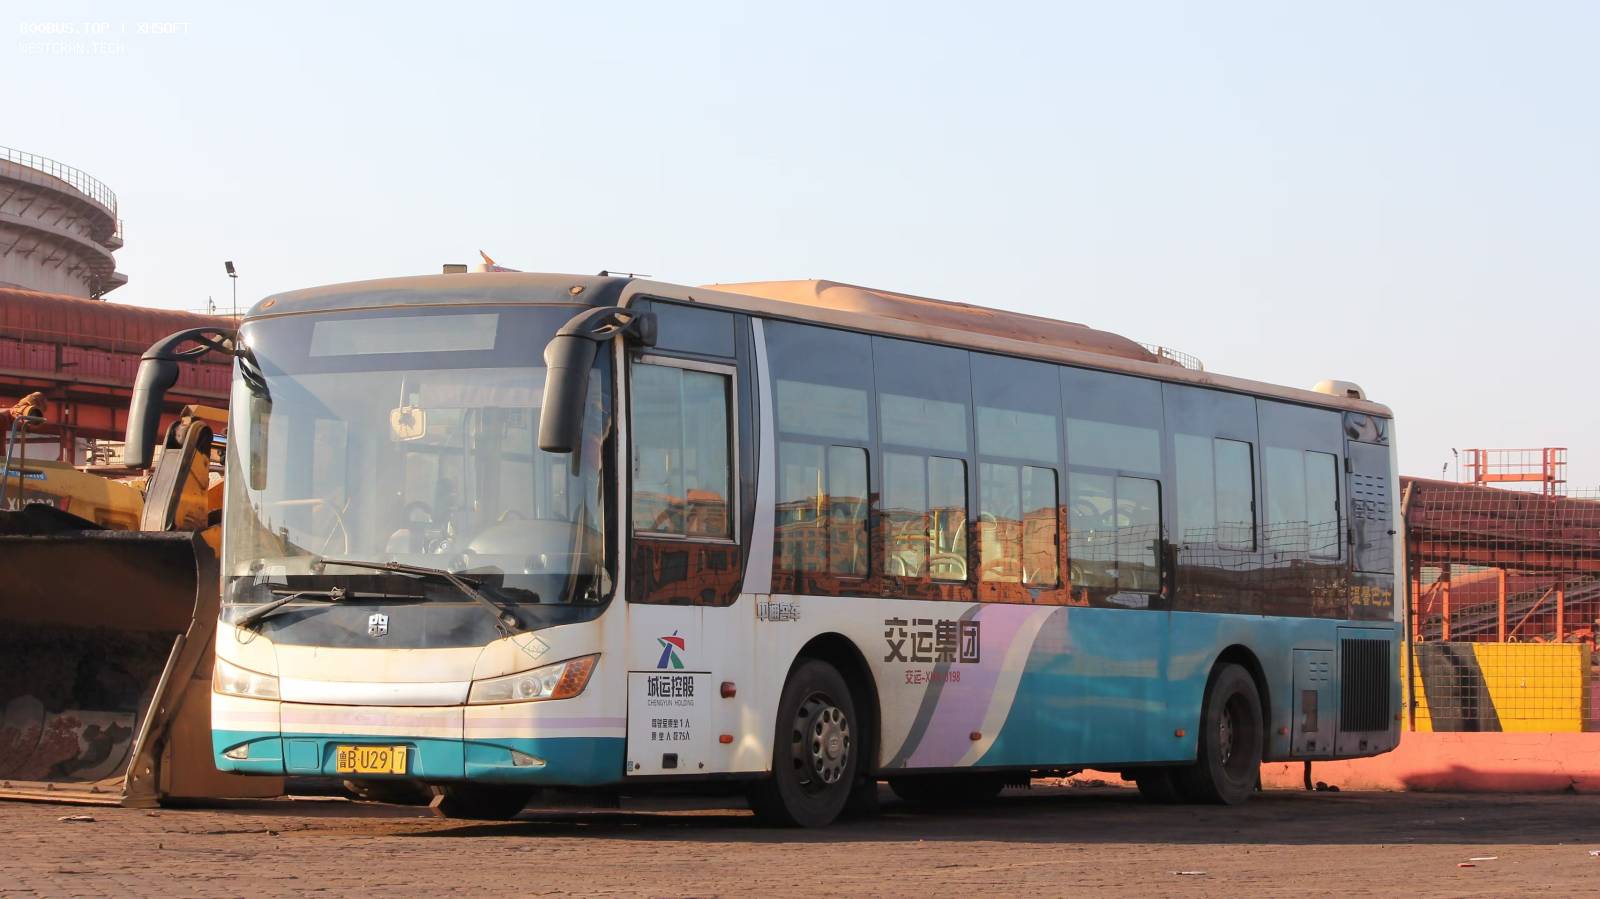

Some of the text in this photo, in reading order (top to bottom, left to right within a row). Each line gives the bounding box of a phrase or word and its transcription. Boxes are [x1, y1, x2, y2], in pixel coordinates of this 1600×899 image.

[884, 617, 980, 663] 交运集团
[648, 676, 694, 697] 城运控股
